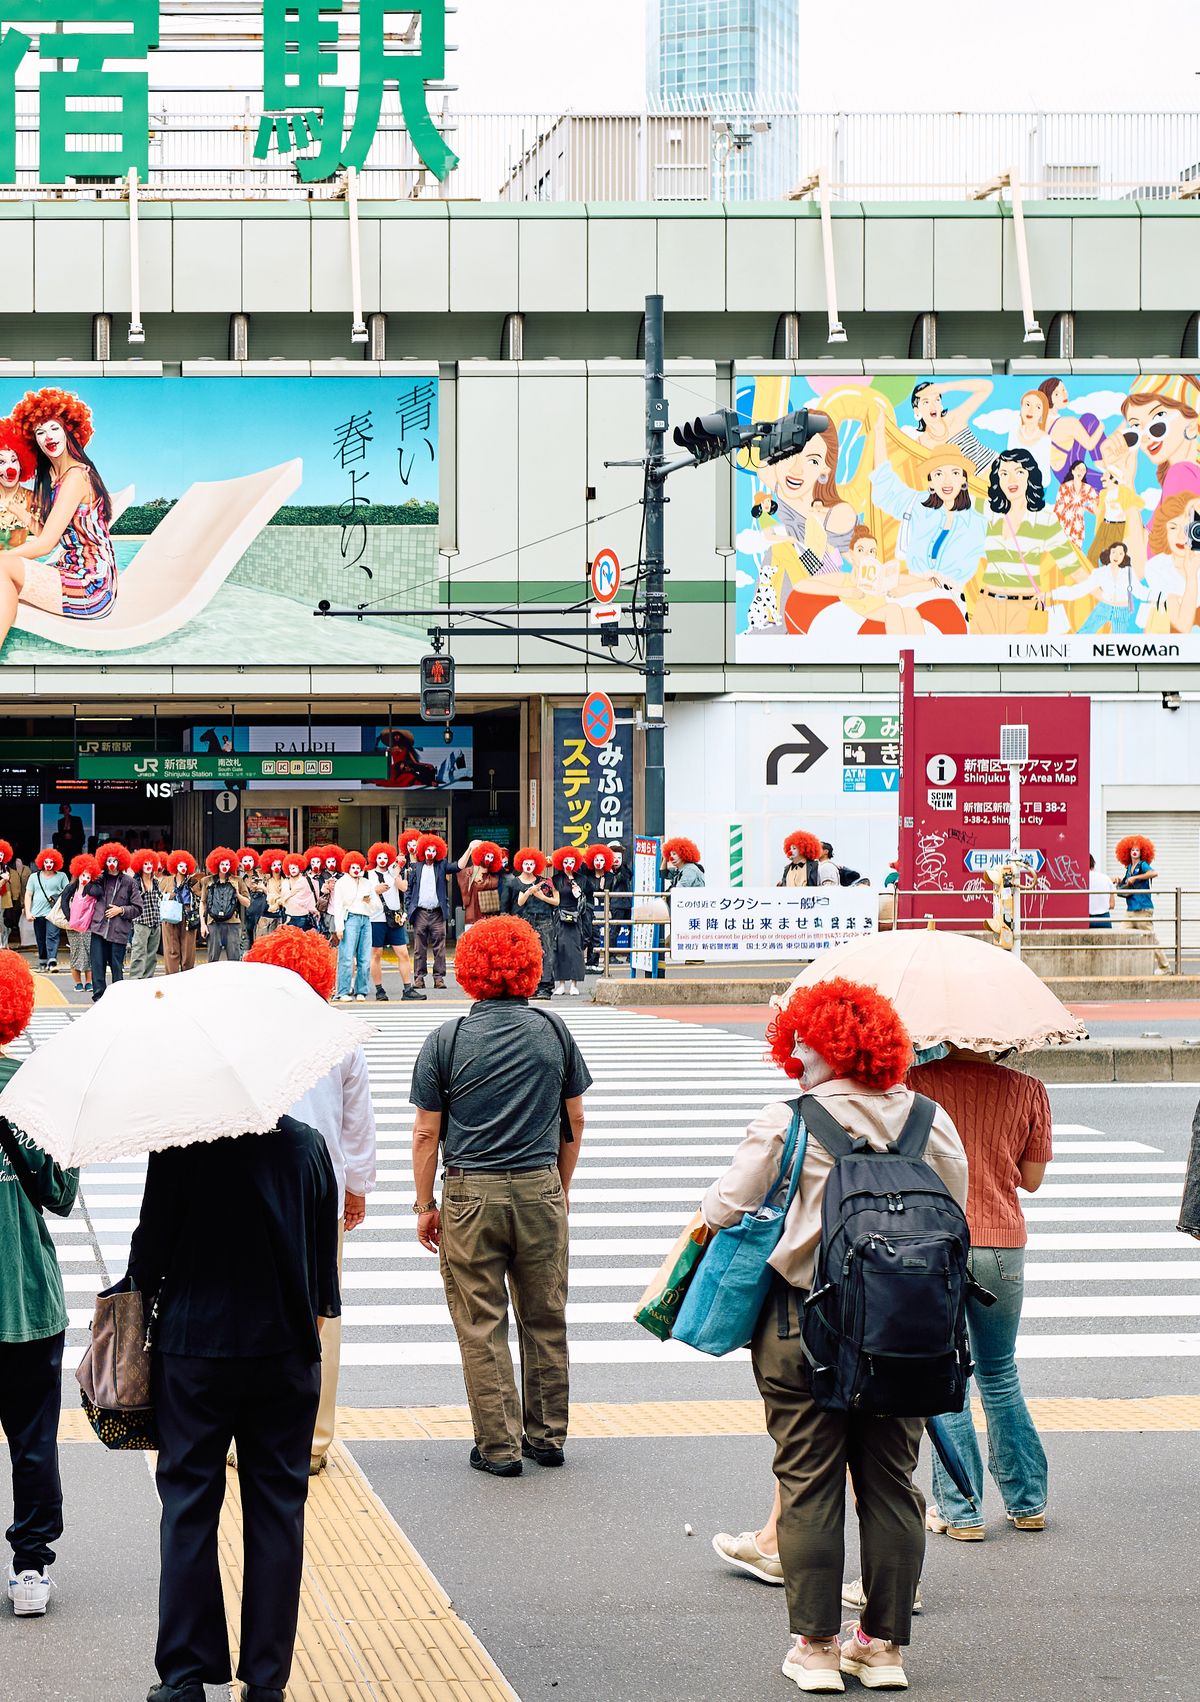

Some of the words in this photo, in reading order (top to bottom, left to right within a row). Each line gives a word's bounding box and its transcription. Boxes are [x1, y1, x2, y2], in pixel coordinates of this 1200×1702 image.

[395, 381, 436, 486] 青い
[1009, 644, 1070, 658] LUMINE
[1093, 643, 1180, 657] NEWoMan
[78, 741, 99, 753] JR
[101, 741, 132, 752] 新宿駅
[880, 743, 899, 764] き
[133, 758, 159, 773] JR
[164, 758, 198, 770] 新宿駅
[218, 758, 241, 767] 南改札
[164, 771, 190, 779] Shinjuku
[844, 769, 866, 778] ATM
[964, 773, 1006, 785] Shinjuku
[1030, 773, 1053, 783] Area
[1055, 773, 1077, 785] Map
[931, 792, 954, 800] SCUM
[963, 802, 1042, 813] 新宿区新宿丁目
[1045, 802, 1067, 813] 38-2
[963, 815, 990, 825] 3-38-2,
[1028, 815, 1044, 826] City
[636, 841, 657, 854] お知らせ
[677, 900, 717, 909] この付近で
[742, 933, 759, 941] picked
[775, 932, 796, 940] dropped
